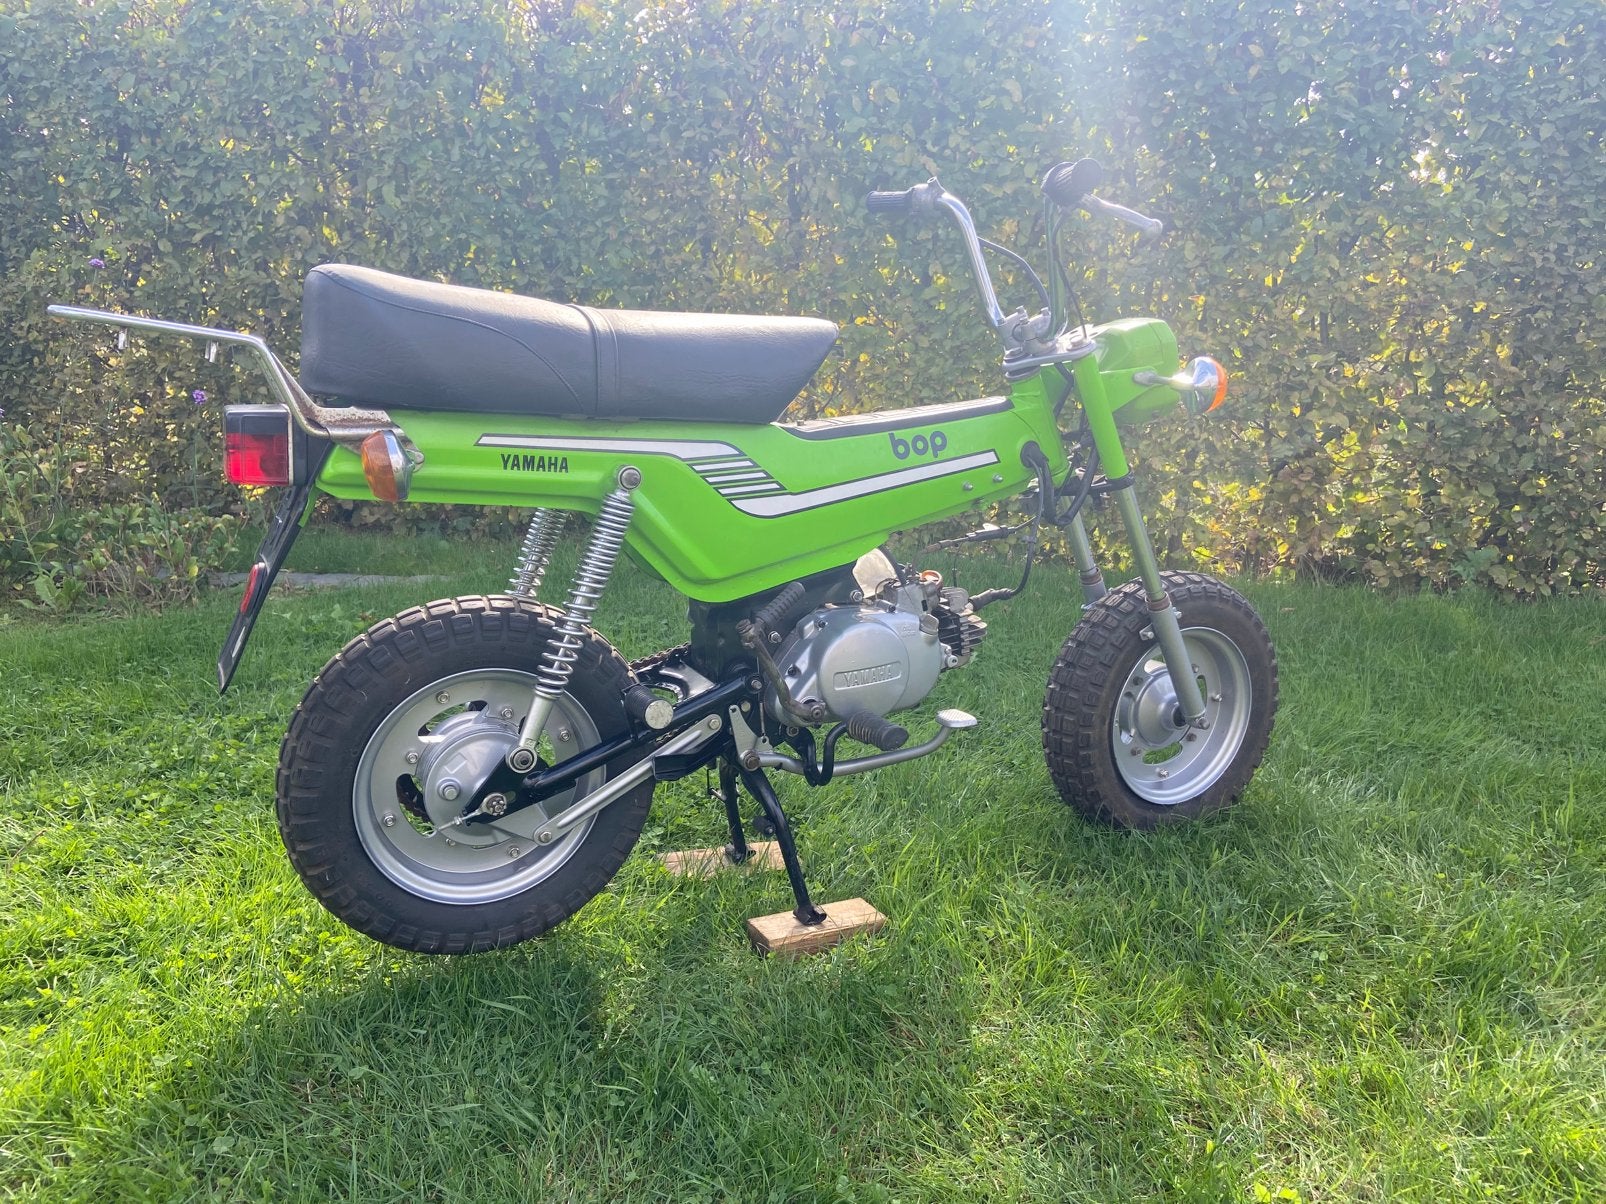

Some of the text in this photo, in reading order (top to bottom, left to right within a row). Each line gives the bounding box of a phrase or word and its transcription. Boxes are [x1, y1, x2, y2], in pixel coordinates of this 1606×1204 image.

[888, 430, 948, 460] bop
[500, 453, 569, 473] YAMAHA
[843, 665, 895, 687] YAMAHA
